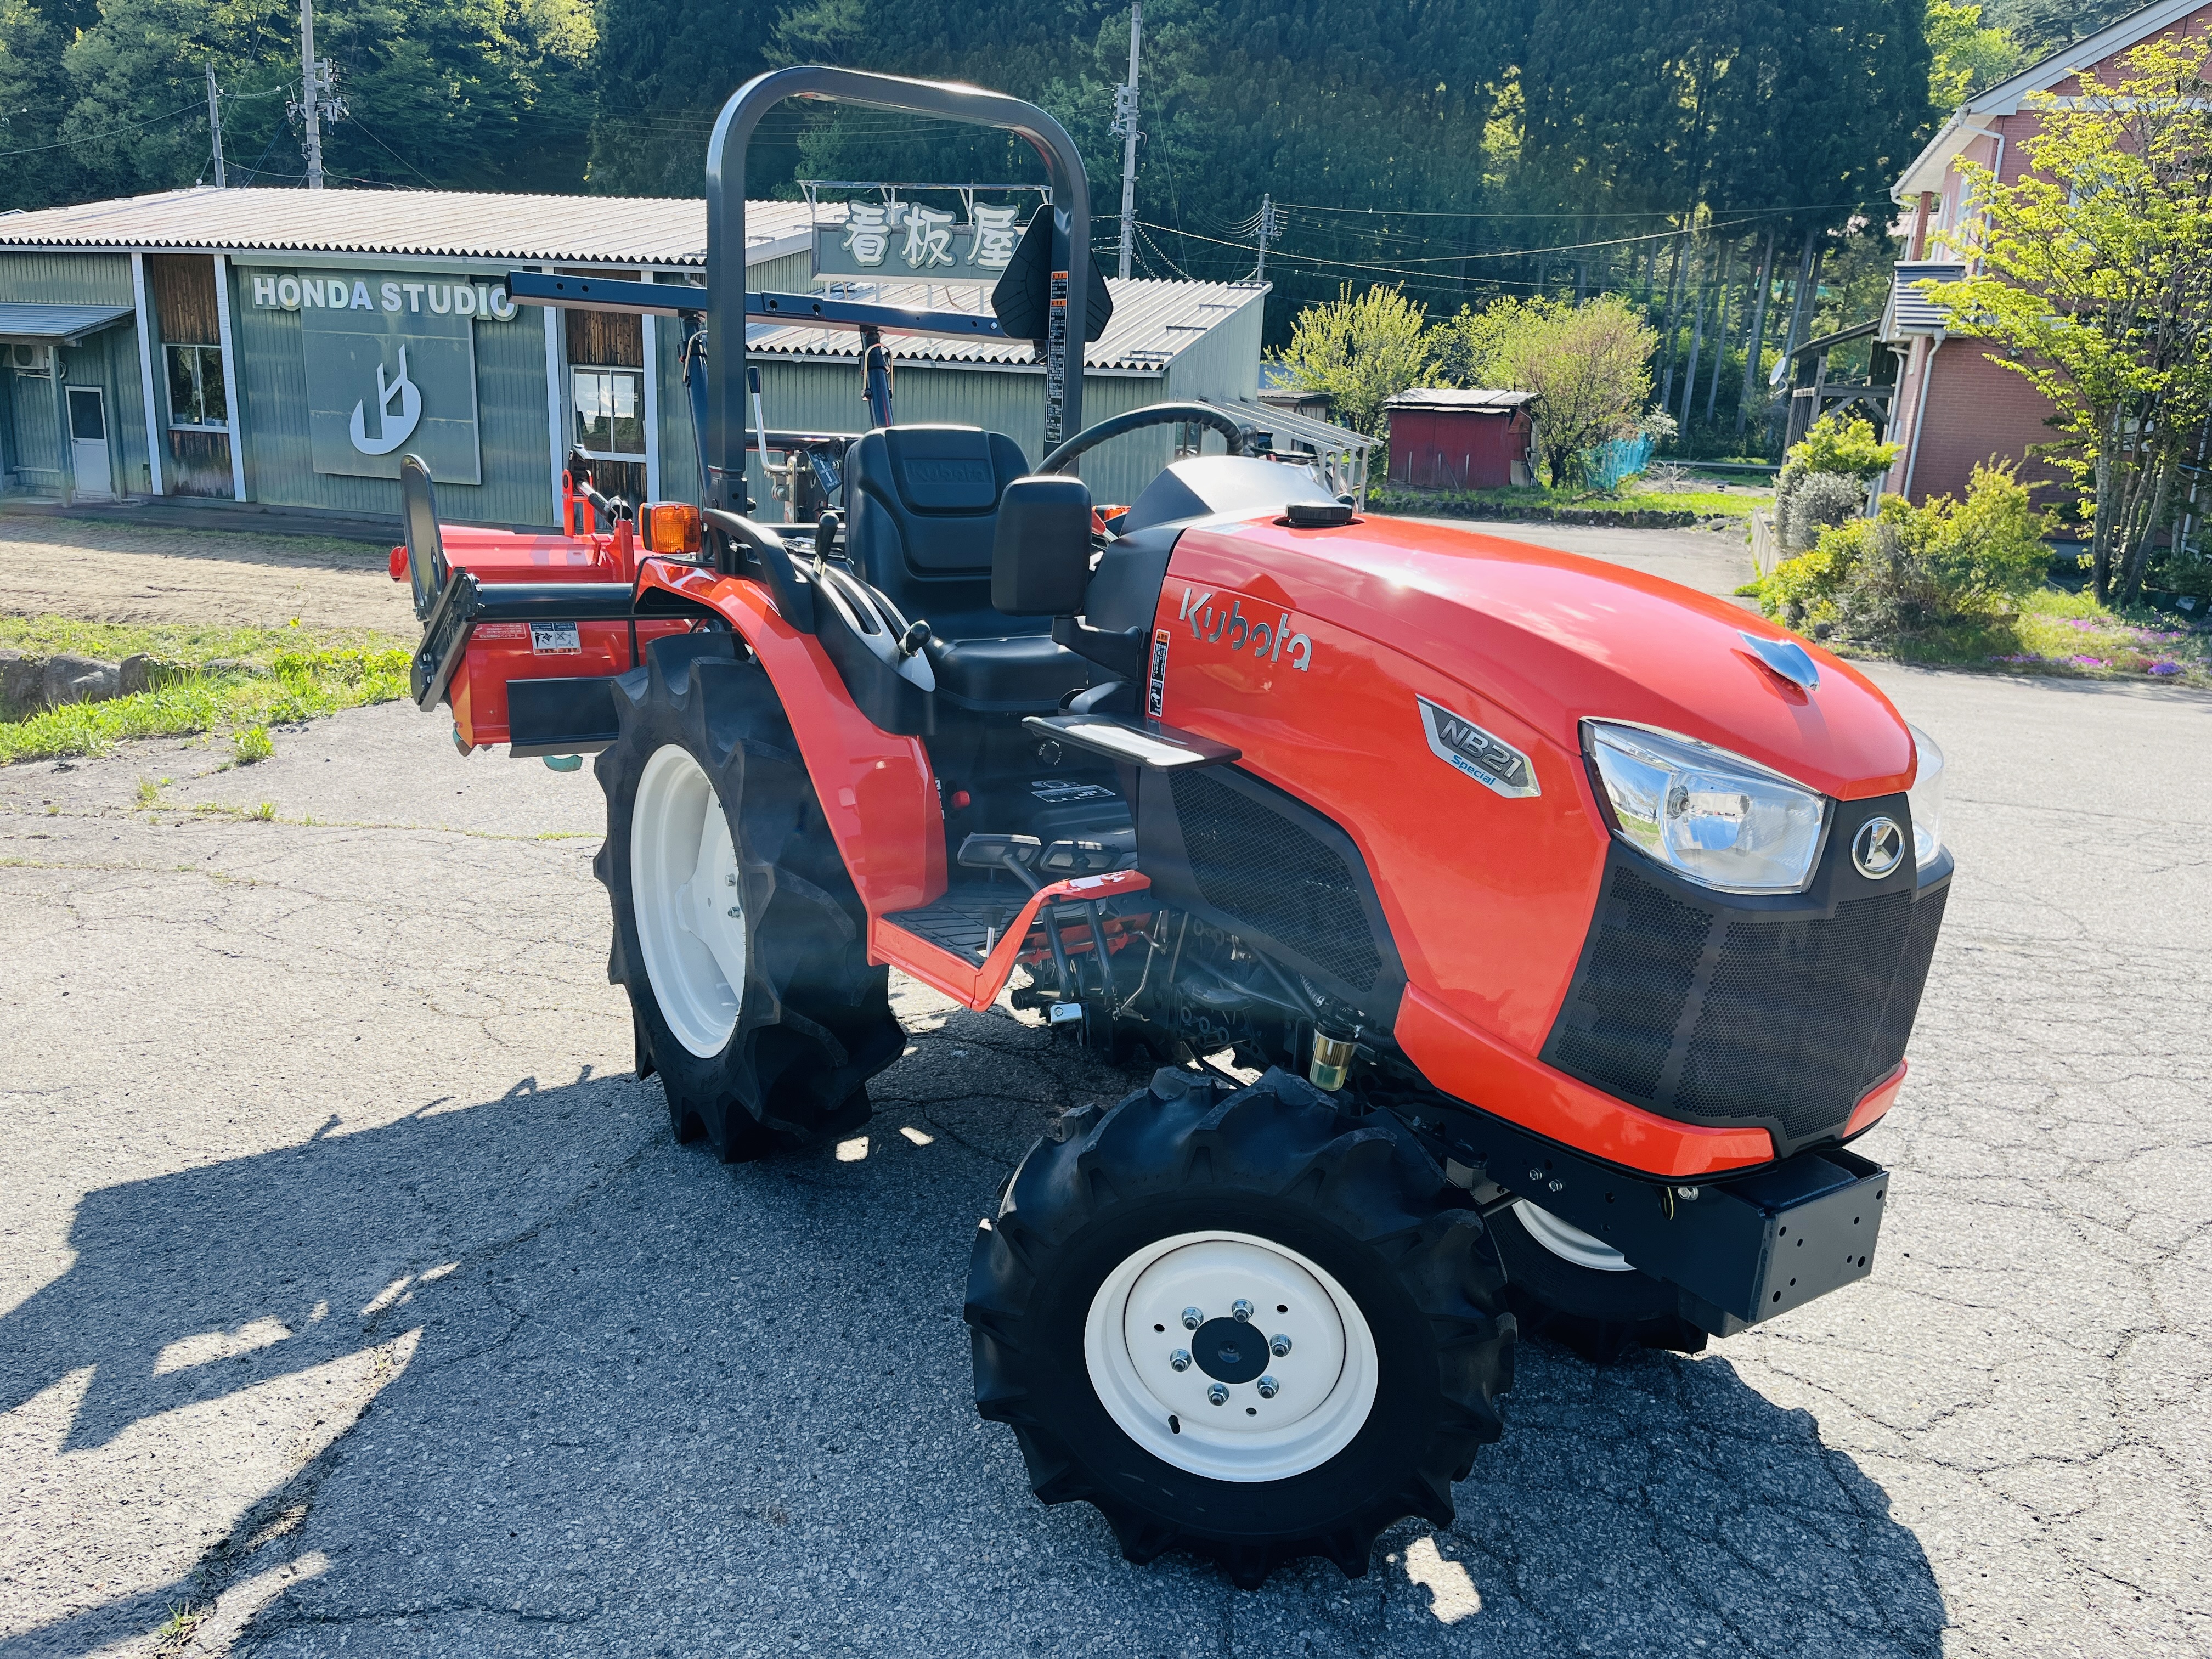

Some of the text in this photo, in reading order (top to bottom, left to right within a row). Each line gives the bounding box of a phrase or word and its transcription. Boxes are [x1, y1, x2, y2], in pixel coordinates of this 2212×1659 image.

[843, 205, 1015, 266] 看板屋
[253, 276, 515, 318] HONDA STUDIO
[908, 463, 986, 482] Kubota
[1178, 588, 1312, 672] Kubota
[1440, 719, 1522, 778] NB21
[1451, 754, 1495, 785] Special
